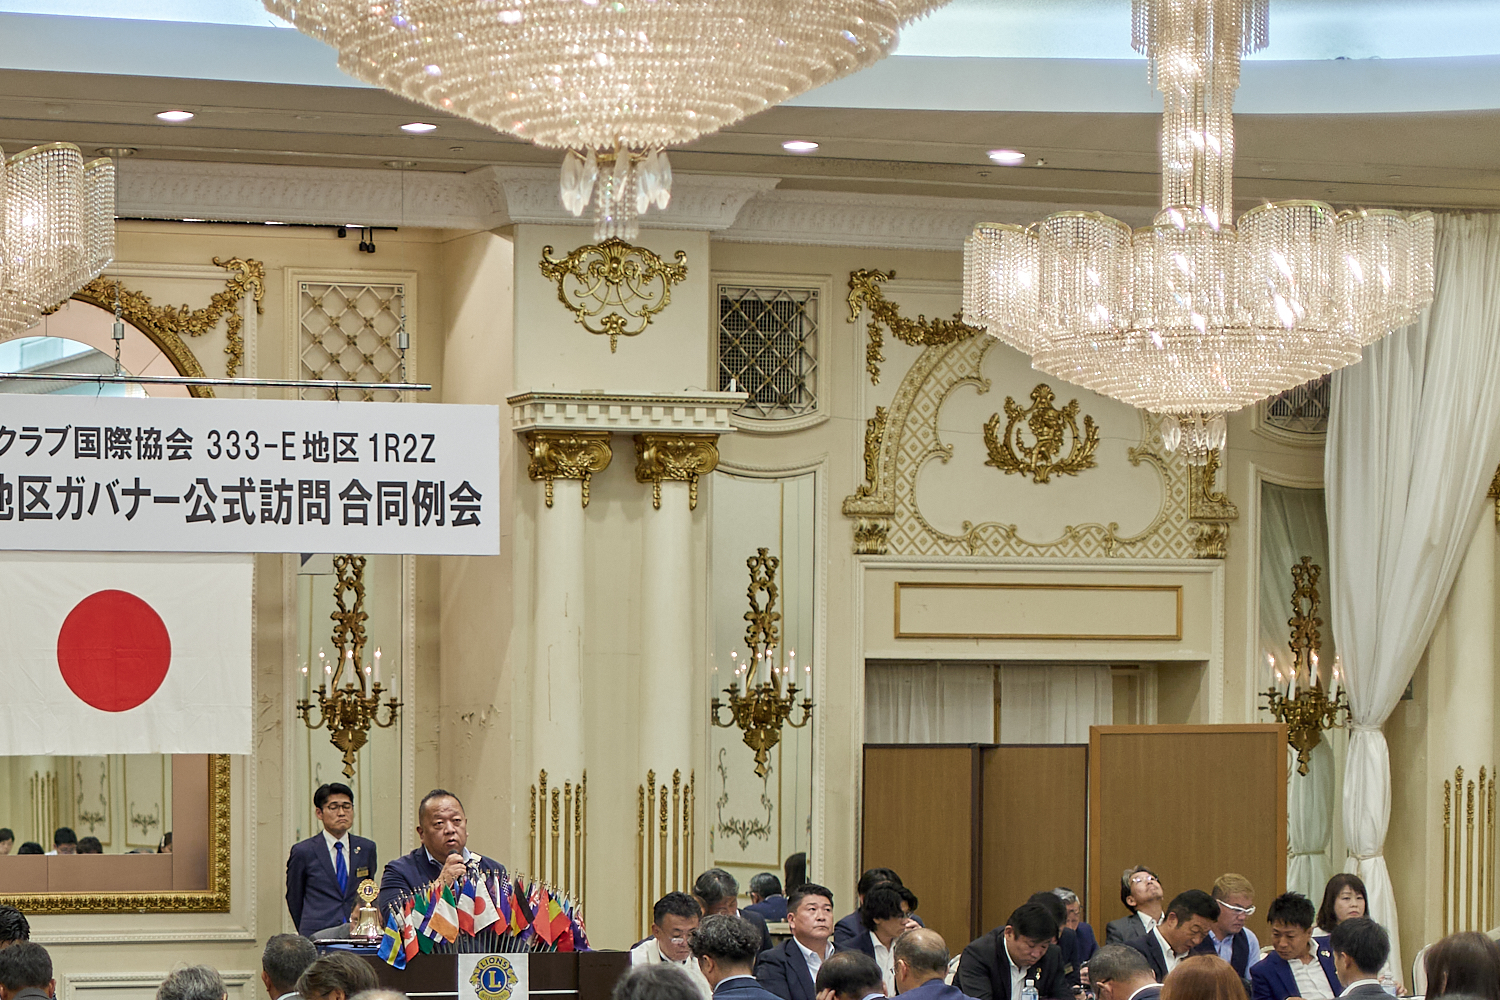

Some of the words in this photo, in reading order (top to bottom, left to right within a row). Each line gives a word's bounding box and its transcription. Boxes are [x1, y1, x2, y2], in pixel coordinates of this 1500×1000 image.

[369, 432, 436, 463] 1R2Z
[338, 478, 483, 527] 合同例会
[479, 957, 508, 968] LIONS
[488, 970, 502, 988] L
